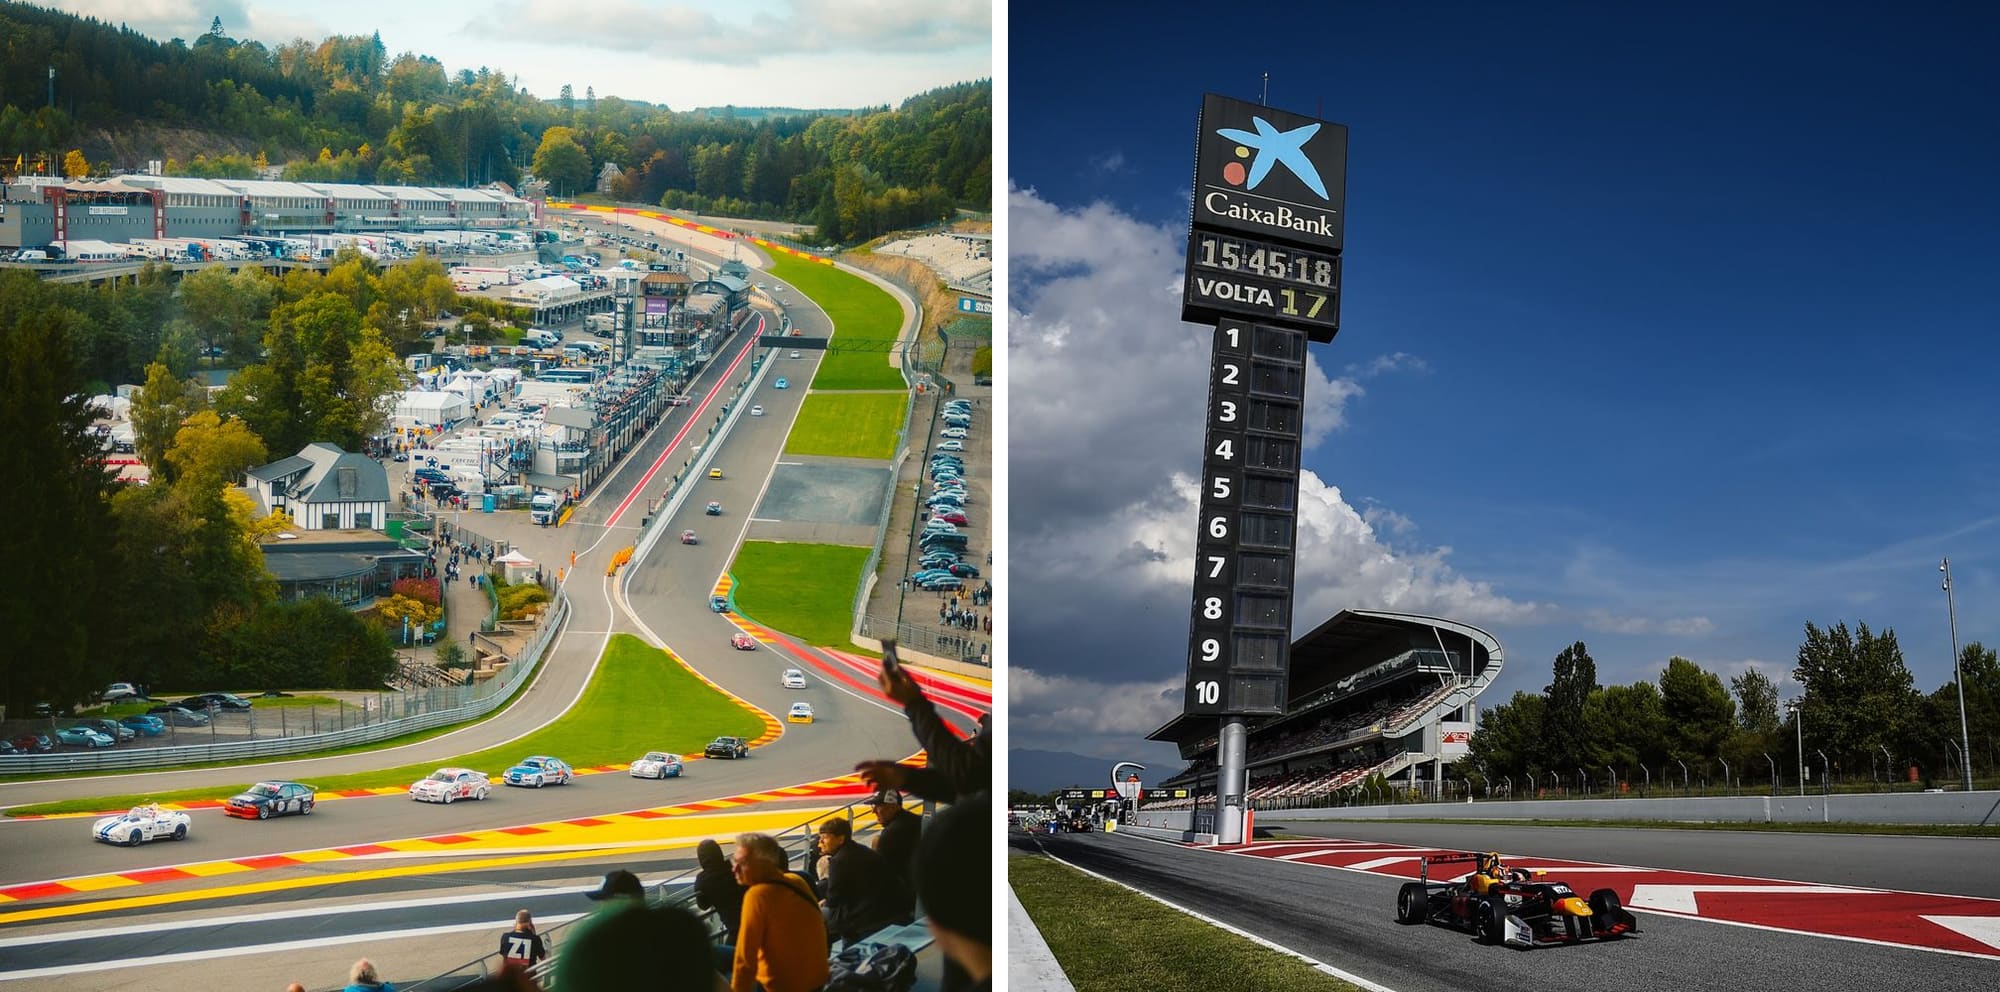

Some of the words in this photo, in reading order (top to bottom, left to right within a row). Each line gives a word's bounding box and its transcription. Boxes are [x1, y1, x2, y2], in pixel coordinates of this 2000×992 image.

[1205, 191, 1334, 237] CaixaBank
[1201, 239, 1331, 287] 15:45:18
[1197, 277, 1274, 307] VOLTA
[1280, 288, 1327, 318] 17
[1226, 328, 1239, 348] 1
[1222, 364, 1239, 385] 2
[1219, 401, 1237, 422] 3
[1215, 439, 1234, 460] 4
[1213, 477, 1230, 499] 5
[1209, 517, 1228, 538] 6
[1208, 556, 1225, 578] 7
[1203, 597, 1222, 619] 8
[1202, 638, 1220, 662] 9
[1195, 680, 1220, 705] 10
